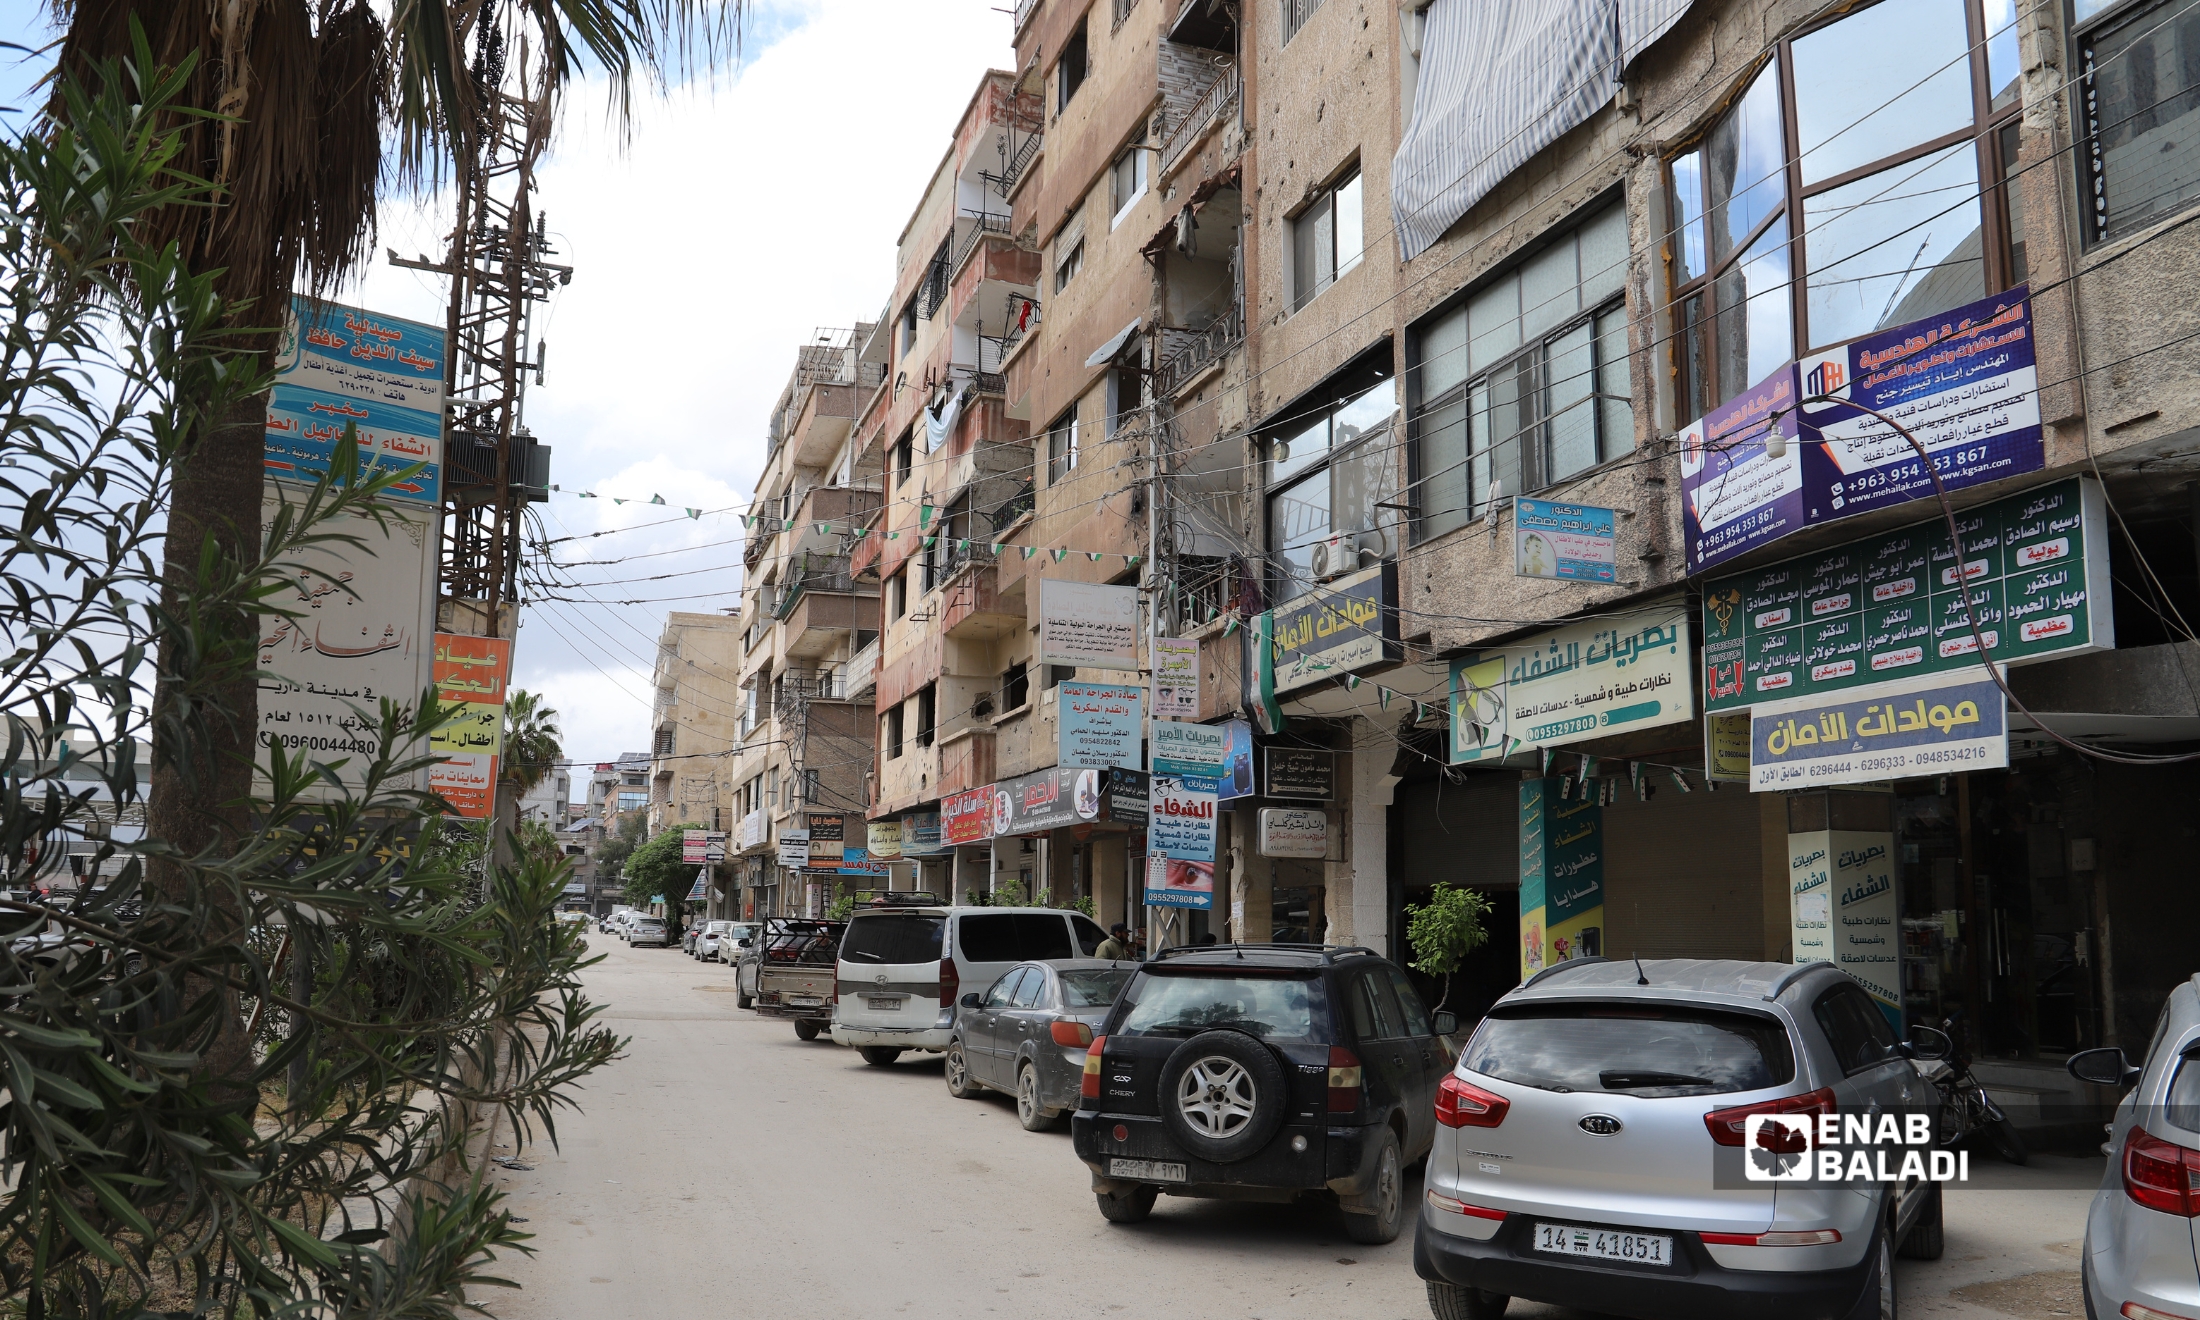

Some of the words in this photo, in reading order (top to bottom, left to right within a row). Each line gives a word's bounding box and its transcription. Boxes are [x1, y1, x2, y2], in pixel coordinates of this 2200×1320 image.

[345, 312, 402, 341] صيدلية
[1941, 303, 2023, 343] الشركة
[306, 327, 347, 349] حافظ
[350, 339, 395, 360] الدين
[1859, 330, 1938, 369] الهندسية
[303, 359, 325, 371] أطفال
[400, 350, 435, 370] سيف
[1966, 353, 2009, 378] المهندس
[326, 361, 348, 378] أغذية
[354, 369, 375, 383] تجميل
[377, 373, 413, 391] مستحضرات
[1963, 379, 2010, 400] استشارات
[383, 389, 406, 401] هاتف
[307, 400, 369, 418] مخبر
[1708, 405, 1747, 439] الهندسية
[1985, 415, 2009, 431] قطع
[382, 437, 431, 457] الشفاء
[1890, 463, 1920, 481] 954
[1956, 445, 1987, 465] 867
[1550, 506, 1582, 516] الدكتور
[2020, 494, 2063, 520] الدكتور
[1520, 514, 1558, 527] مصطفى
[1725, 524, 1741, 538] 954
[1742, 516, 1756, 531] 353
[1758, 507, 1774, 522] 867
[2049, 513, 2081, 536] وسيم
[1594, 524, 1611, 535] علي
[2005, 523, 2045, 546] الصادق
[1584, 540, 1591, 548] في
[1877, 538, 1911, 559] الدكتور
[1969, 535, 1998, 553] محمد
[2026, 544, 2060, 560] بولية
[1813, 555, 1849, 577] الدكتور
[1905, 555, 1925, 572] عمر
[1755, 571, 1790, 592] الدكتور
[1835, 572, 1859, 590] عمار
[1892, 583, 1914, 595] داخلية
[2024, 570, 2068, 595] الدكتور
[297, 570, 355, 609] جمعية
[1746, 596, 1776, 613] الصادق
[1814, 603, 1828, 612] عامة
[1829, 597, 1849, 608] جراحة
[2008, 596, 2050, 620] الحمود
[1048, 617, 1068, 626] التناسلية
[1070, 619, 1086, 629] البولية
[1087, 621, 1106, 630] الجراحة
[1317, 597, 1378, 638] مولدات
[1762, 611, 1785, 627] أسنان
[1881, 608, 1912, 628] الدكتور
[1106, 623, 1112, 633] في
[1113, 624, 1131, 632] ماجستير
[1817, 622, 1849, 641] الدكتور
[1909, 624, 1929, 637] محمد
[2027, 621, 2067, 638] عظمية
[300, 619, 412, 660] الشفاء
[1586, 624, 1678, 671] بصريات
[1761, 635, 1788, 652] الدكتور
[1838, 641, 1862, 654] محمد
[1156, 640, 1197, 657] بصريات
[1161, 656, 1192, 672] الأميرة
[1509, 638, 1580, 687] الشفاء
[1748, 660, 1763, 672] أحمد
[1839, 662, 1854, 672] غدد
[1639, 672, 1672, 692] نظارات
[1761, 675, 1788, 688] عظمية
[307, 682, 359, 699] مدينة
[363, 686, 377, 703] في
[1063, 685, 1084, 696] العامة
[1087, 687, 1116, 700] الجراحة
[1118, 689, 1137, 701] عيادة
[1574, 685, 1607, 706] شمسية
[1615, 682, 1638, 699] طبية
[1072, 702, 1103, 714] السكرية
[1105, 704, 1129, 716] والقدم
[1515, 705, 1539, 719] لاصقة
[1539, 700, 1569, 714] عدسات
[265, 710, 291, 724] لعام
[299, 711, 332, 726] ١٥١٢
[1856, 699, 1980, 737] مولدات
[1110, 729, 1130, 737] الدكتور
[1158, 726, 1183, 742] الأمير
[1535, 716, 1595, 740] 0955297808
[1767, 712, 1848, 755] الأمان
[280, 734, 375, 755] 0960044480
[458, 732, 494, 747] أطفال
[1186, 730, 1221, 746] بصريات
[1071, 747, 1091, 757] شعبان
[1092, 750, 1108, 758] رسلان
[1109, 750, 1128, 758] الدكتور
[1080, 758, 1121, 766] 0938330021
[1272, 761, 1285, 771] خليل
[1287, 761, 1299, 773] شيخ
[1810, 762, 1852, 777] 6296444
[1860, 756, 1906, 772] 6296333
[1915, 746, 1986, 765] 0948534216
[447, 770, 485, 786] معاينات
[1780, 766, 1806, 782] الطابق
[458, 789, 477, 798] داريا
[1023, 771, 1059, 815] الأحمر
[458, 801, 476, 809] هاتف
[963, 795, 977, 814] سلة
[1153, 798, 1213, 819] الشفاء
[1285, 811, 1309, 819] الدكتور
[1155, 818, 1181, 829] طبية
[1184, 821, 1211, 830] نظارات
[1287, 820, 1305, 830] بشير
[1154, 829, 1181, 840] شمسية
[1184, 831, 1211, 841] نظارات
[1554, 821, 1596, 849] الشفاء
[1154, 840, 1180, 851] لاصقة
[1181, 842, 1209, 852] عدسات
[1793, 849, 1826, 869] بصريات
[1838, 844, 1886, 869] بصريات
[1554, 852, 1598, 878] عطورات
[1148, 892, 1193, 904] 0955297808
[1553, 880, 1599, 908] هدايا
[1841, 875, 1890, 907] الشفاء
[1842, 916, 1863, 926] طبية
[1864, 916, 1891, 925] نظارات
[1800, 938, 1823, 948] وشمسية
[1849, 934, 1885, 946] وشمسية
[1841, 954, 1865, 964] لاصقة
[1868, 955, 1897, 963] عدسات
[1109, 1089, 1136, 1097] CHERY
[1585, 1118, 1616, 1133] KIA
[1542, 1227, 1567, 1250] 14
[1595, 1233, 1662, 1262] 41851
